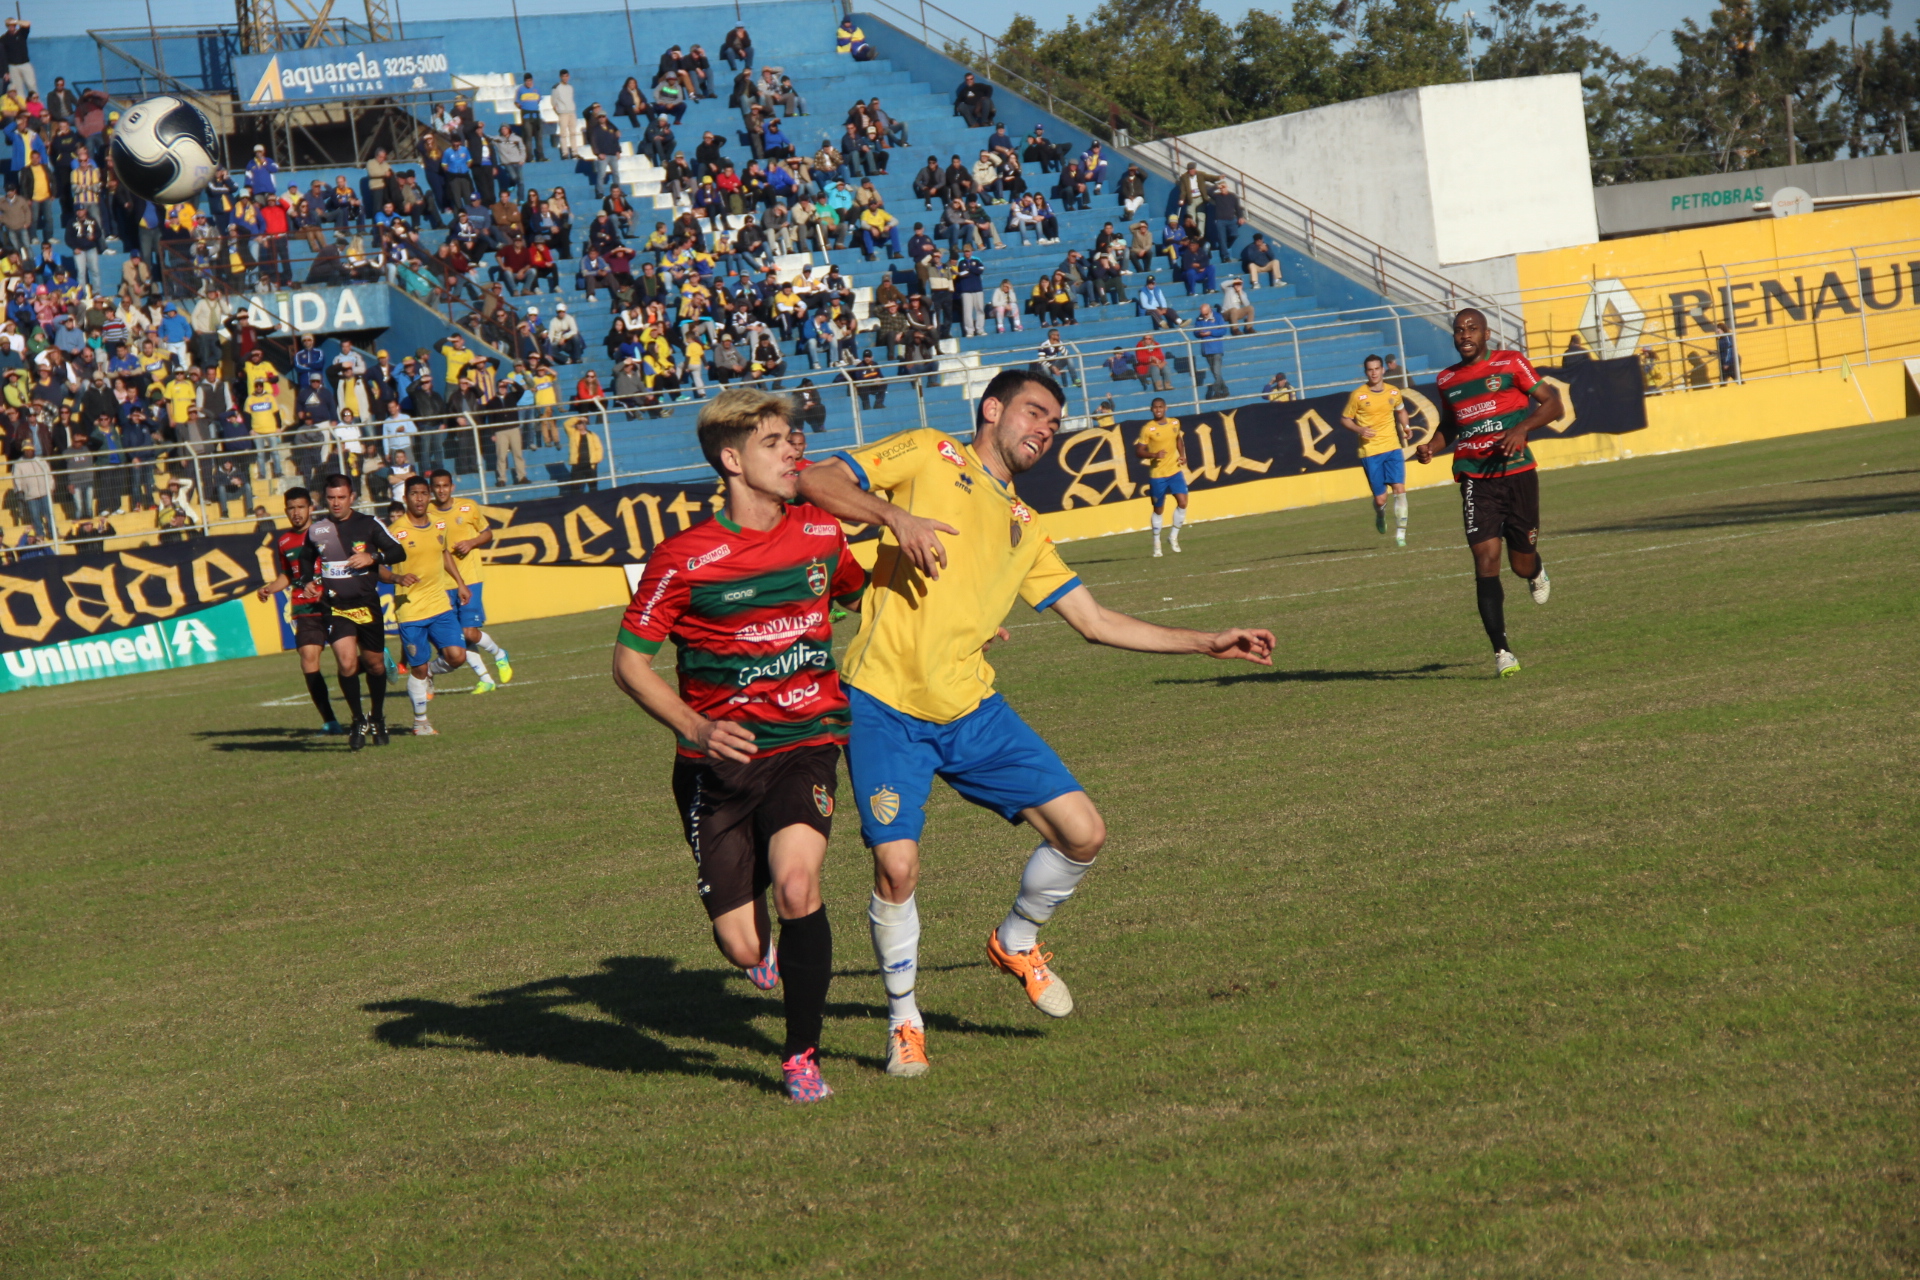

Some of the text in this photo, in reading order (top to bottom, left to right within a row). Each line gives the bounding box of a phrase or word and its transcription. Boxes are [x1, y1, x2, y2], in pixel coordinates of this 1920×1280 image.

[282, 51, 448, 93] aquarela 3225-5000
[329, 80, 384, 94] TINTAS
[1671, 186, 1764, 211] PETROBRAS
[639, 568, 678, 626] TRAMONTINA
[3, 623, 163, 678] Unimed
